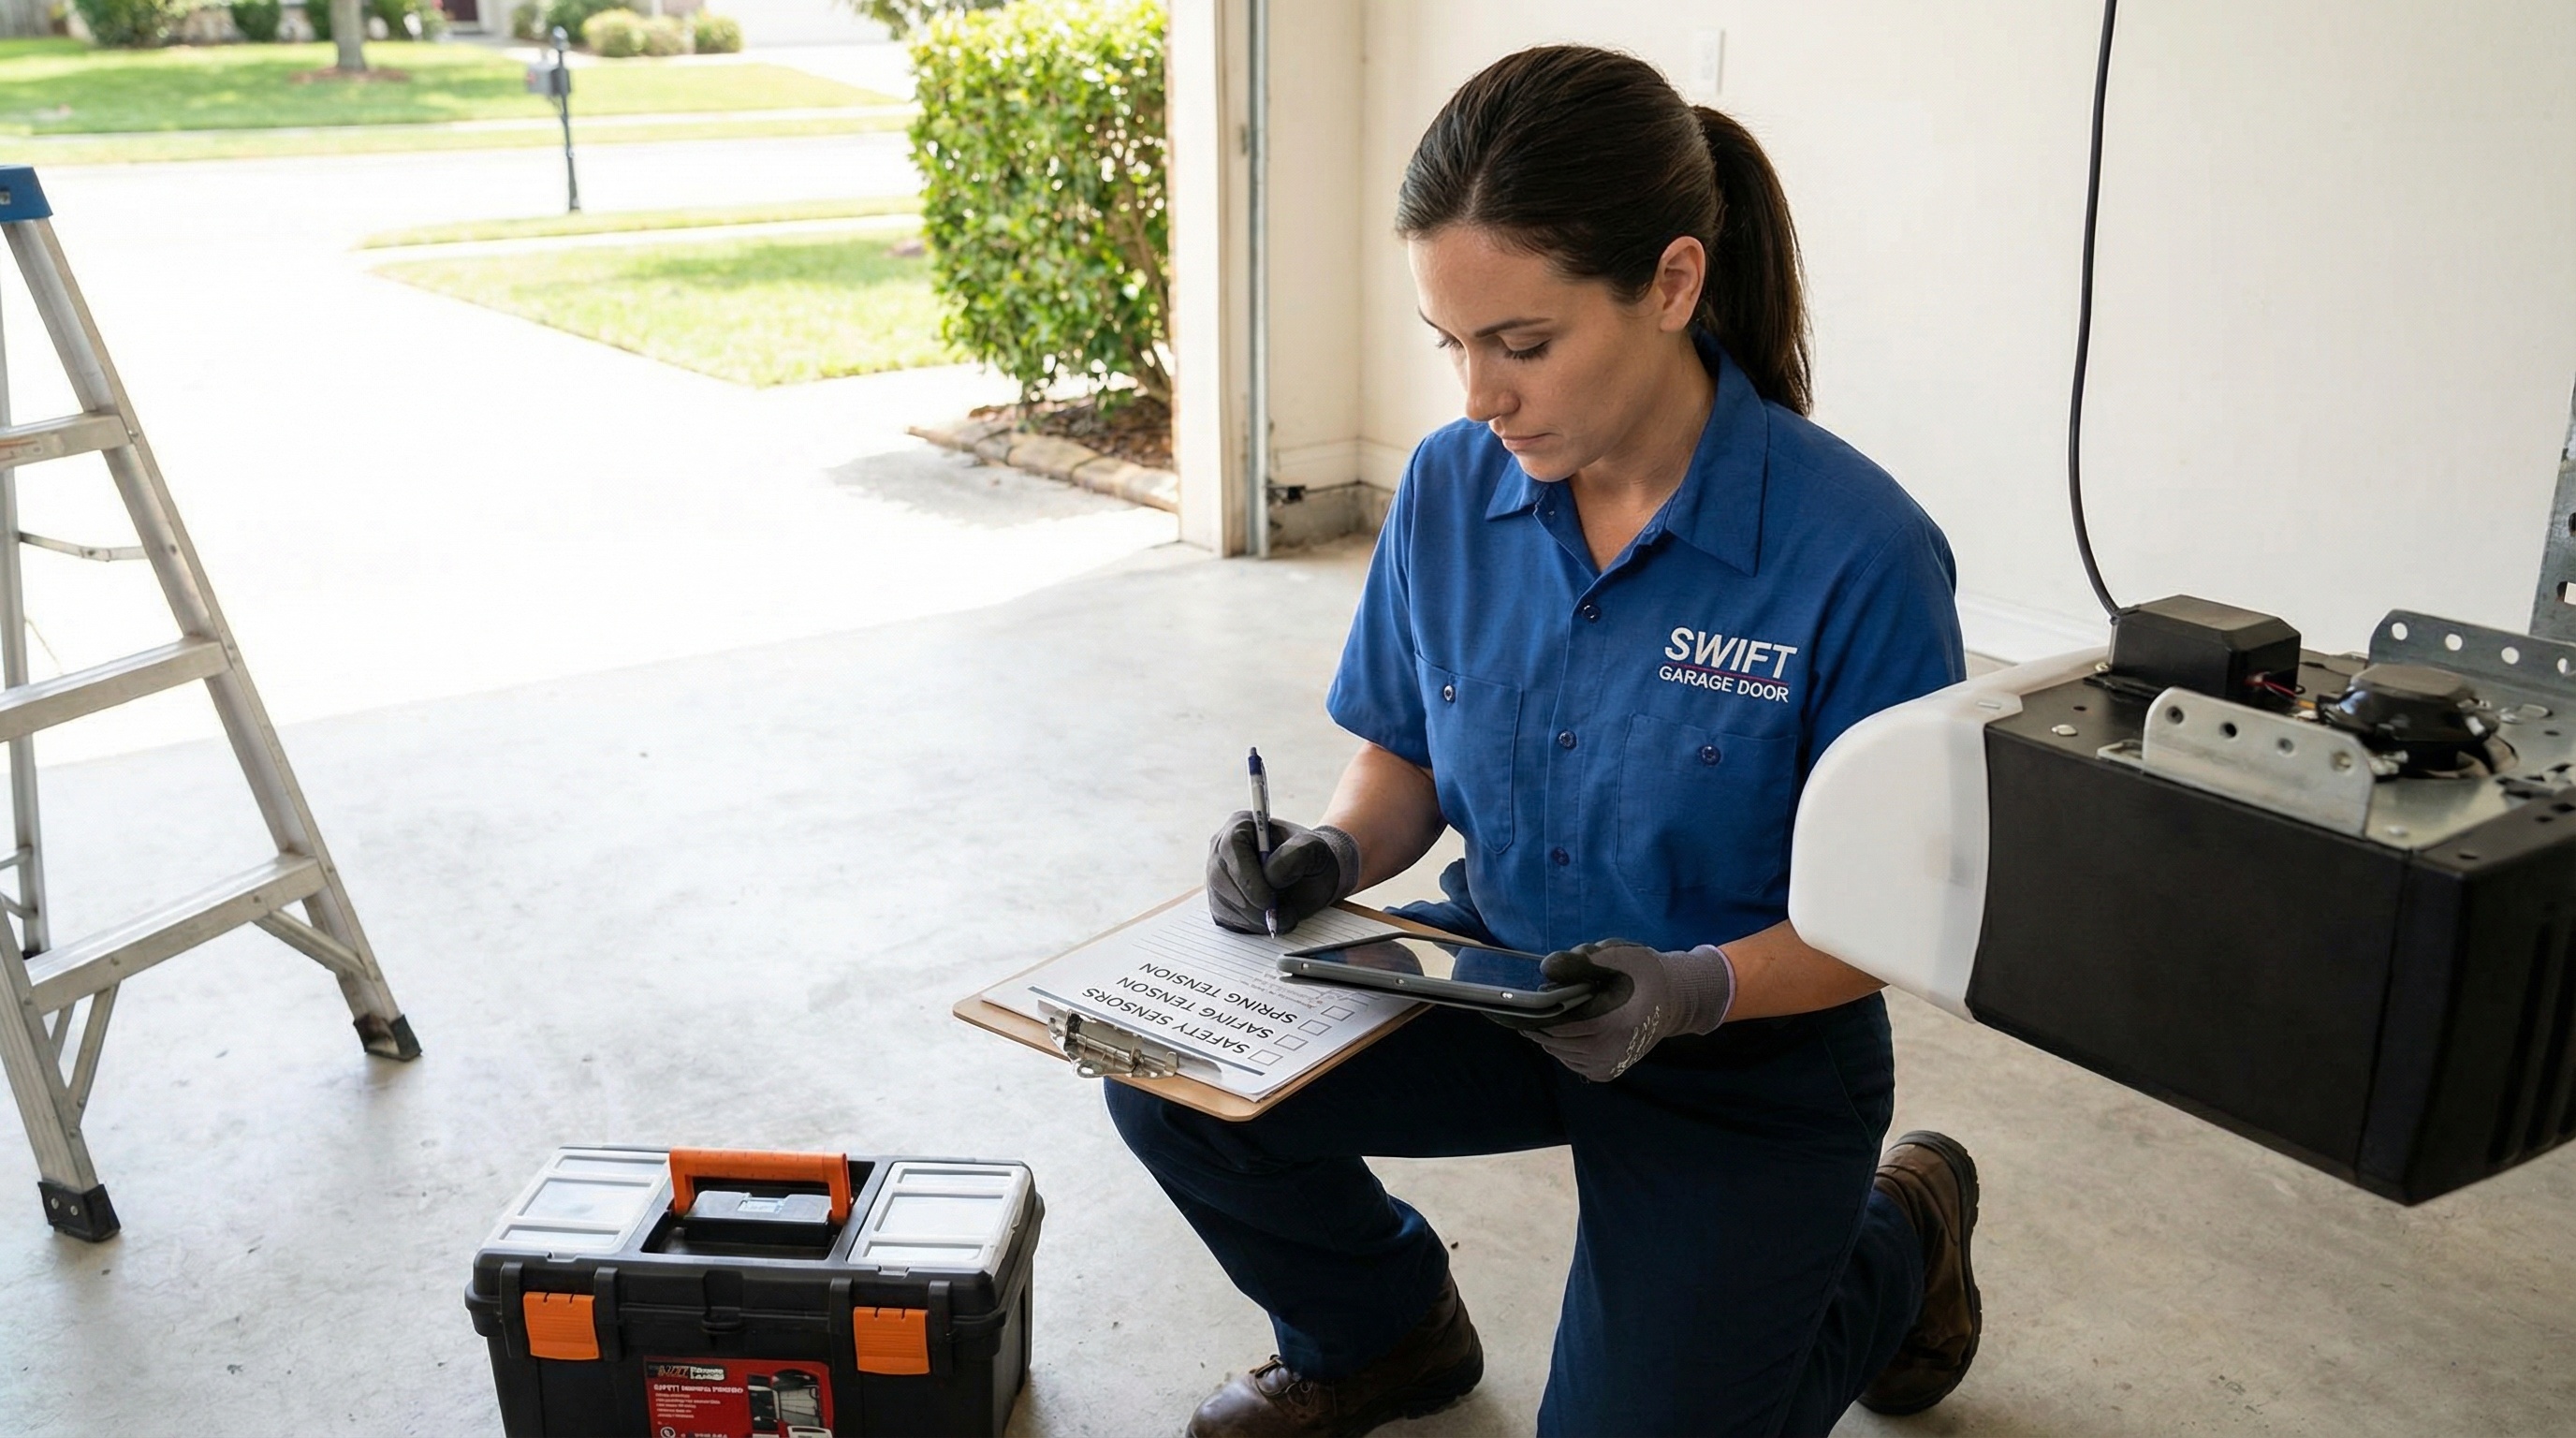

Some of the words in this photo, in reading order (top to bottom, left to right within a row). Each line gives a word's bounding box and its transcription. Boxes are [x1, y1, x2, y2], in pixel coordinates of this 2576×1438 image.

[1664, 627, 1797, 679] SWIFT
[1659, 666, 1734, 693] GARAGE
[1736, 680, 1789, 702] DOOR
[1116, 976, 1196, 1011] TENSON
[1139, 962, 1222, 997] TENSION
[1082, 988, 1174, 1025] SENSORS
[1226, 992, 1297, 1023] SPRING
[1171, 1022, 1250, 1054] SAFETY
